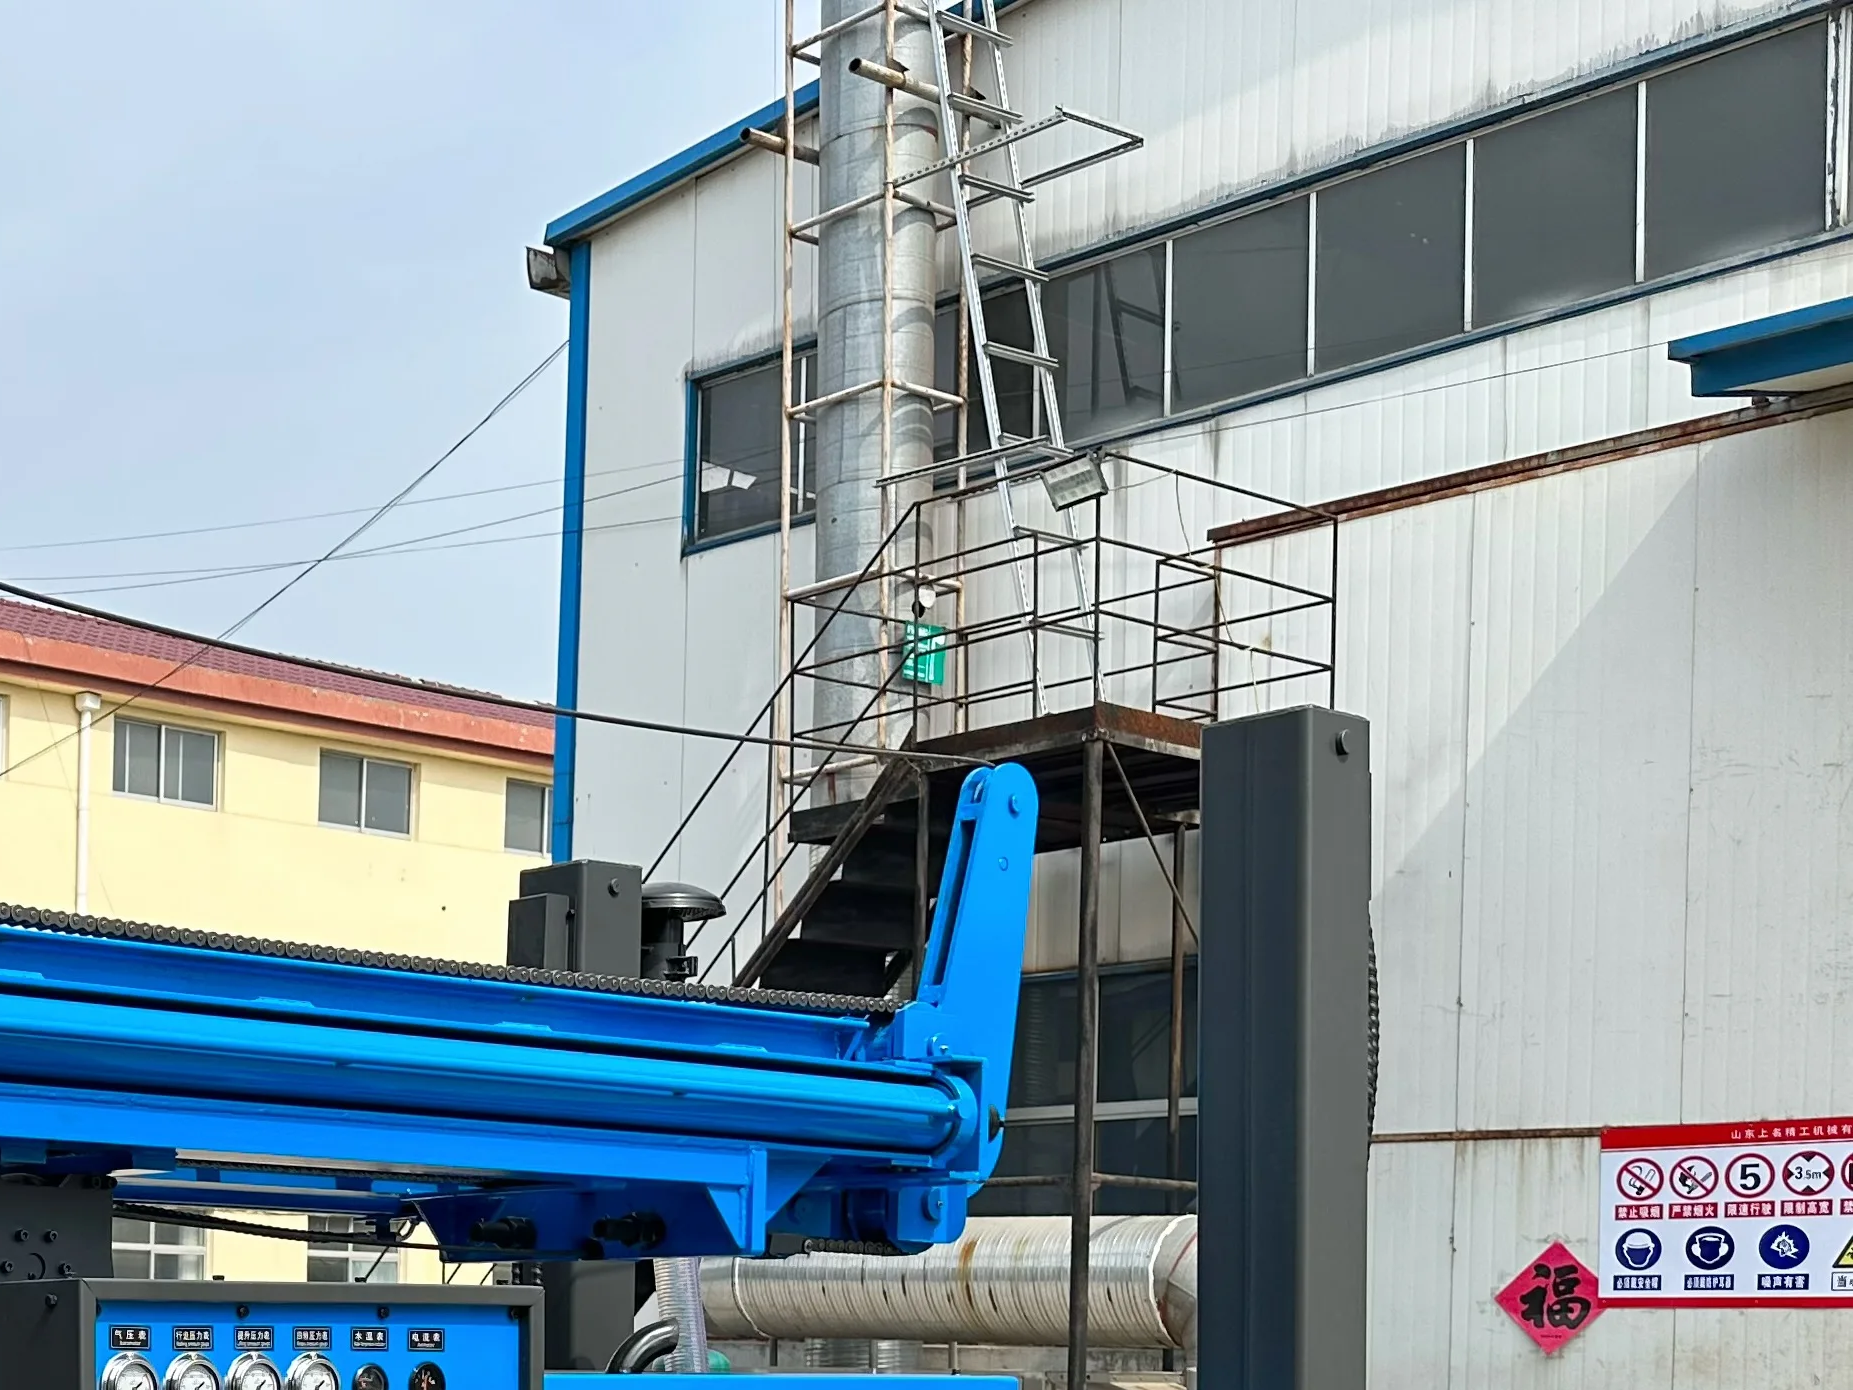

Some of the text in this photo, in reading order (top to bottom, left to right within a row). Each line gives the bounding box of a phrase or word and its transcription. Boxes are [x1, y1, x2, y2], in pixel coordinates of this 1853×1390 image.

[1739, 1163, 1761, 1191] 5
[1617, 1205, 1661, 1219] 禁止吸烟
[1671, 1204, 1715, 1217] 严禁烟火
[1726, 1203, 1772, 1216] 限速行驶
[1783, 1201, 1830, 1214] 限制高宽
[1761, 1276, 1805, 1288] 噪声有害
[1518, 1263, 1591, 1330] 福
